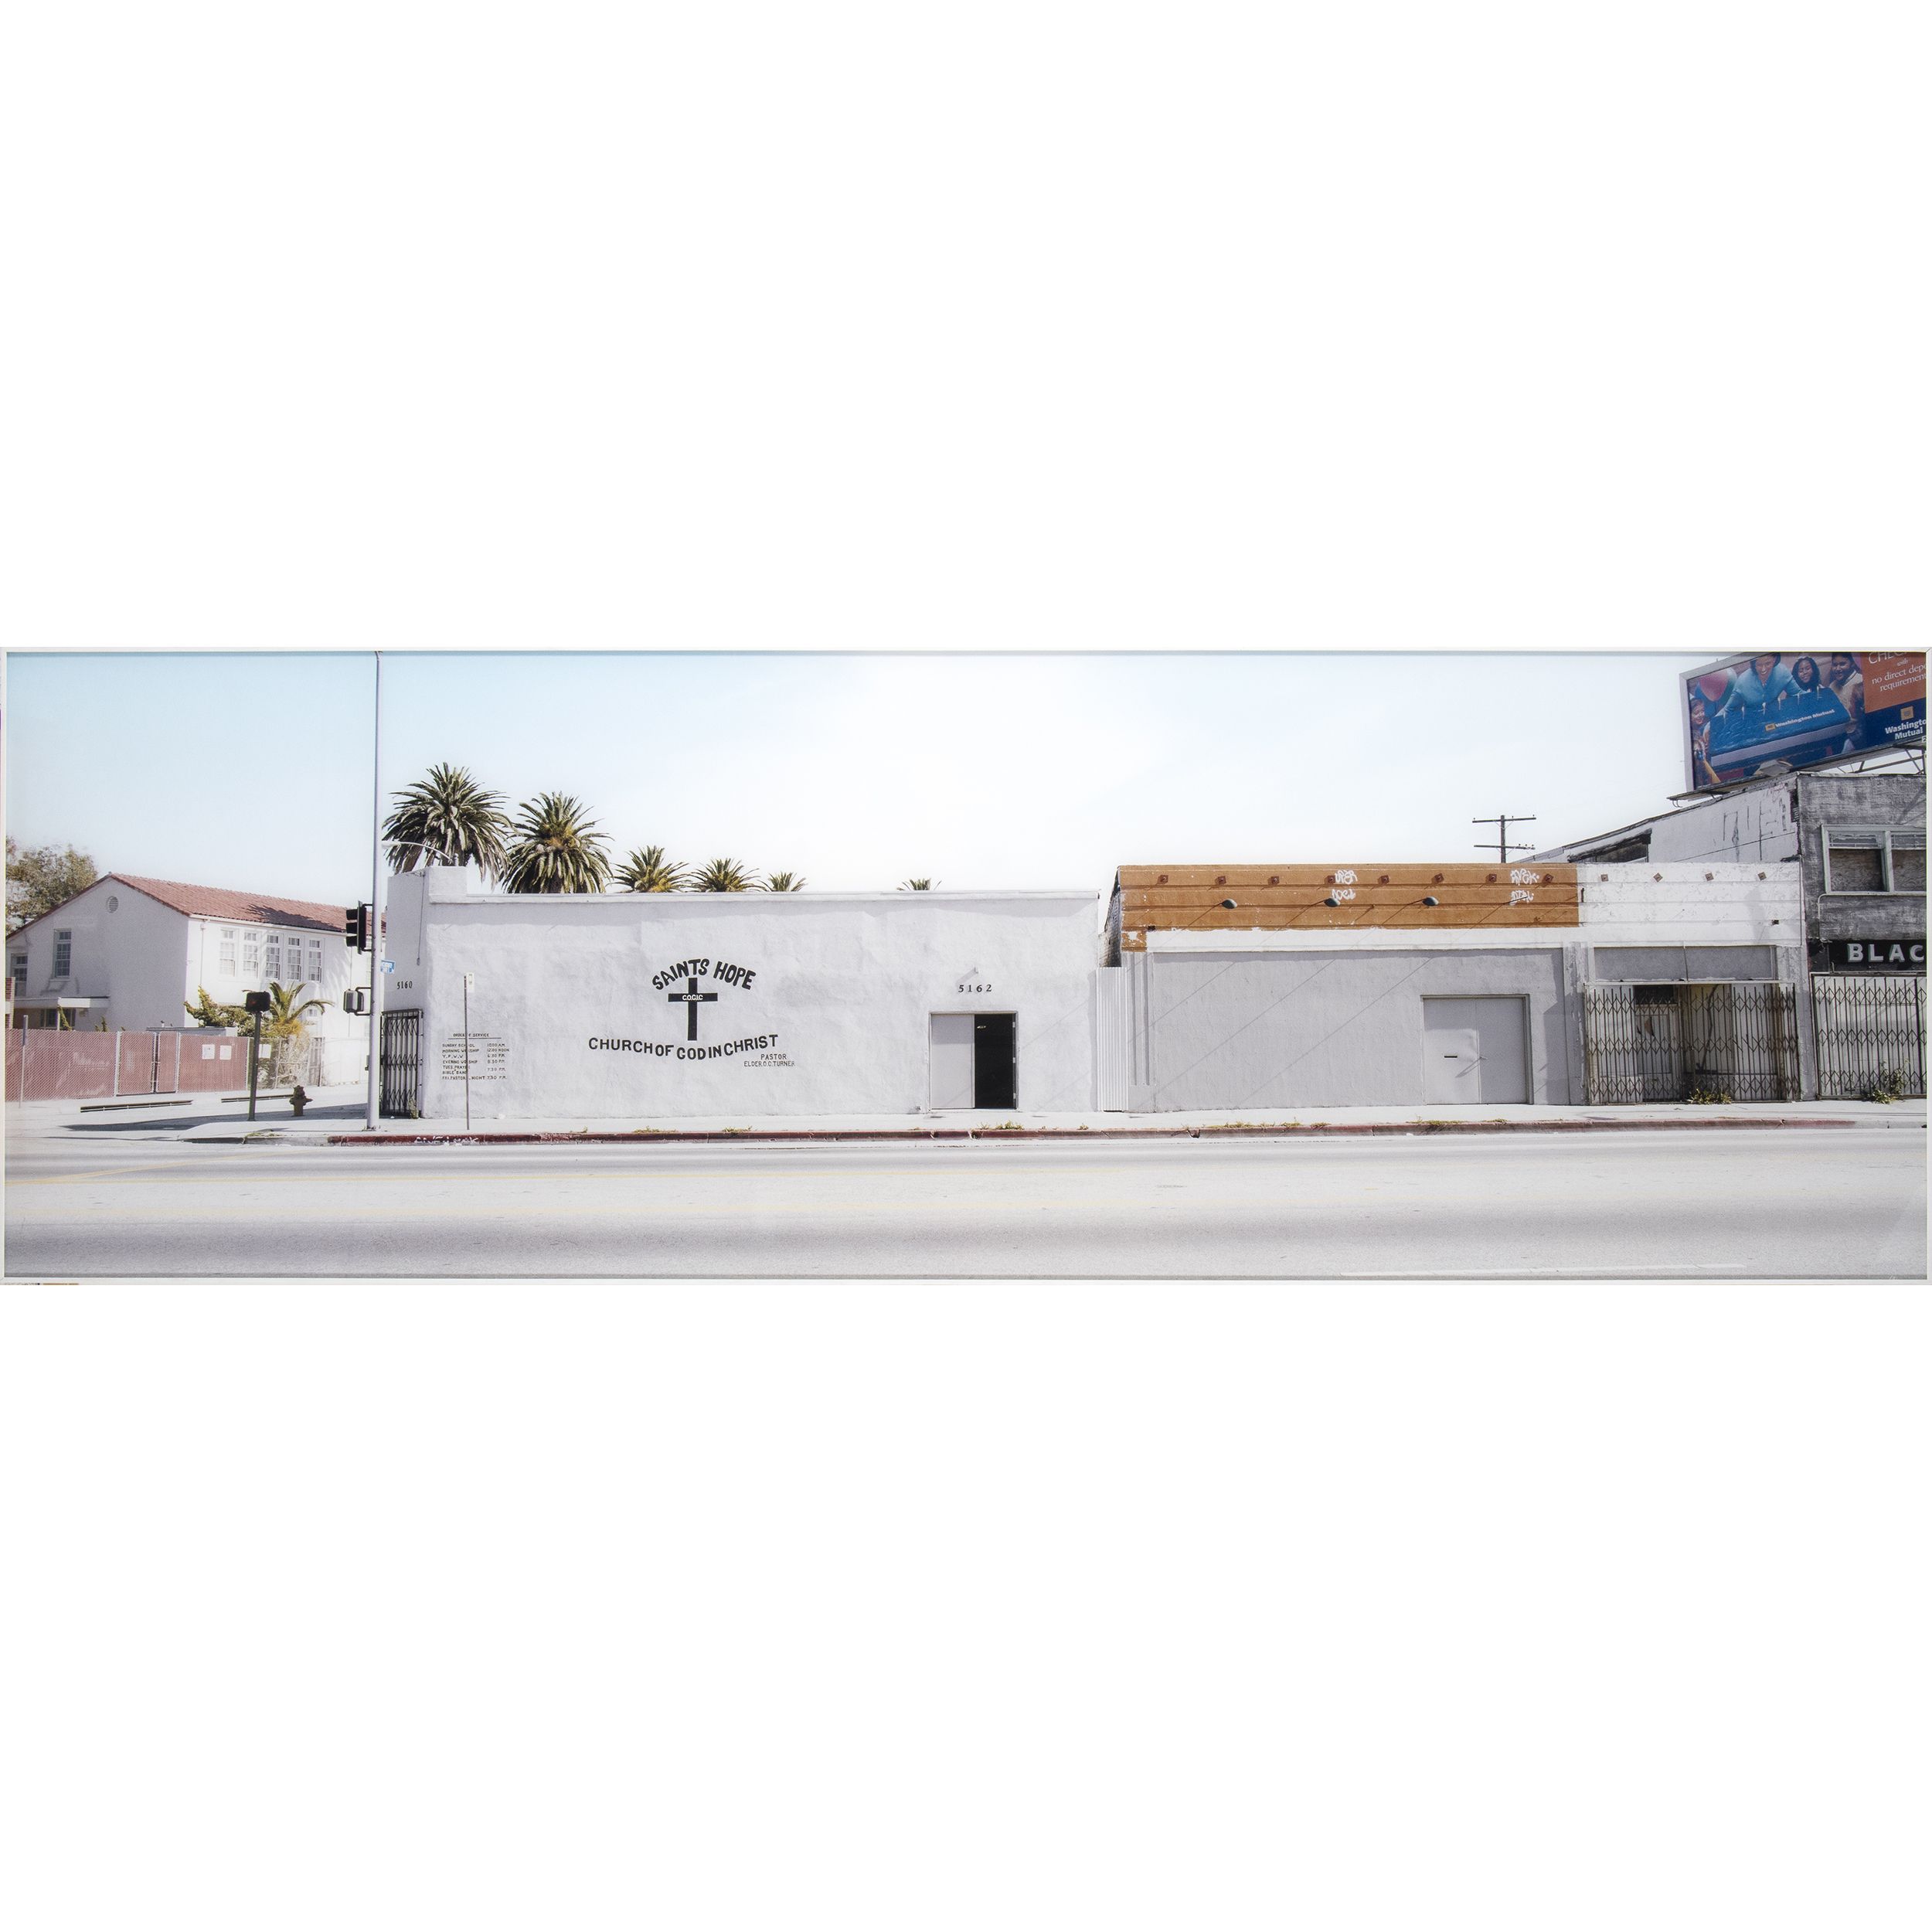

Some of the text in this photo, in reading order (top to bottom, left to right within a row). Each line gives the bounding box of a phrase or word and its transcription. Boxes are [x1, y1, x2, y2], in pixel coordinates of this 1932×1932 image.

[1872, 675, 1882, 685] no
[1884, 668, 1906, 681] direct
[1775, 709, 1835, 727] Washington Mutual
[1894, 726, 1923, 740] Mutual
[1847, 943, 1924, 963] BLAC
[651, 958, 757, 990] SAINTS HOPE
[396, 981, 413, 990] 5160
[957, 984, 992, 993] 5162
[588, 1034, 778, 1060] CHURCH OF GOD IN CHRIST
